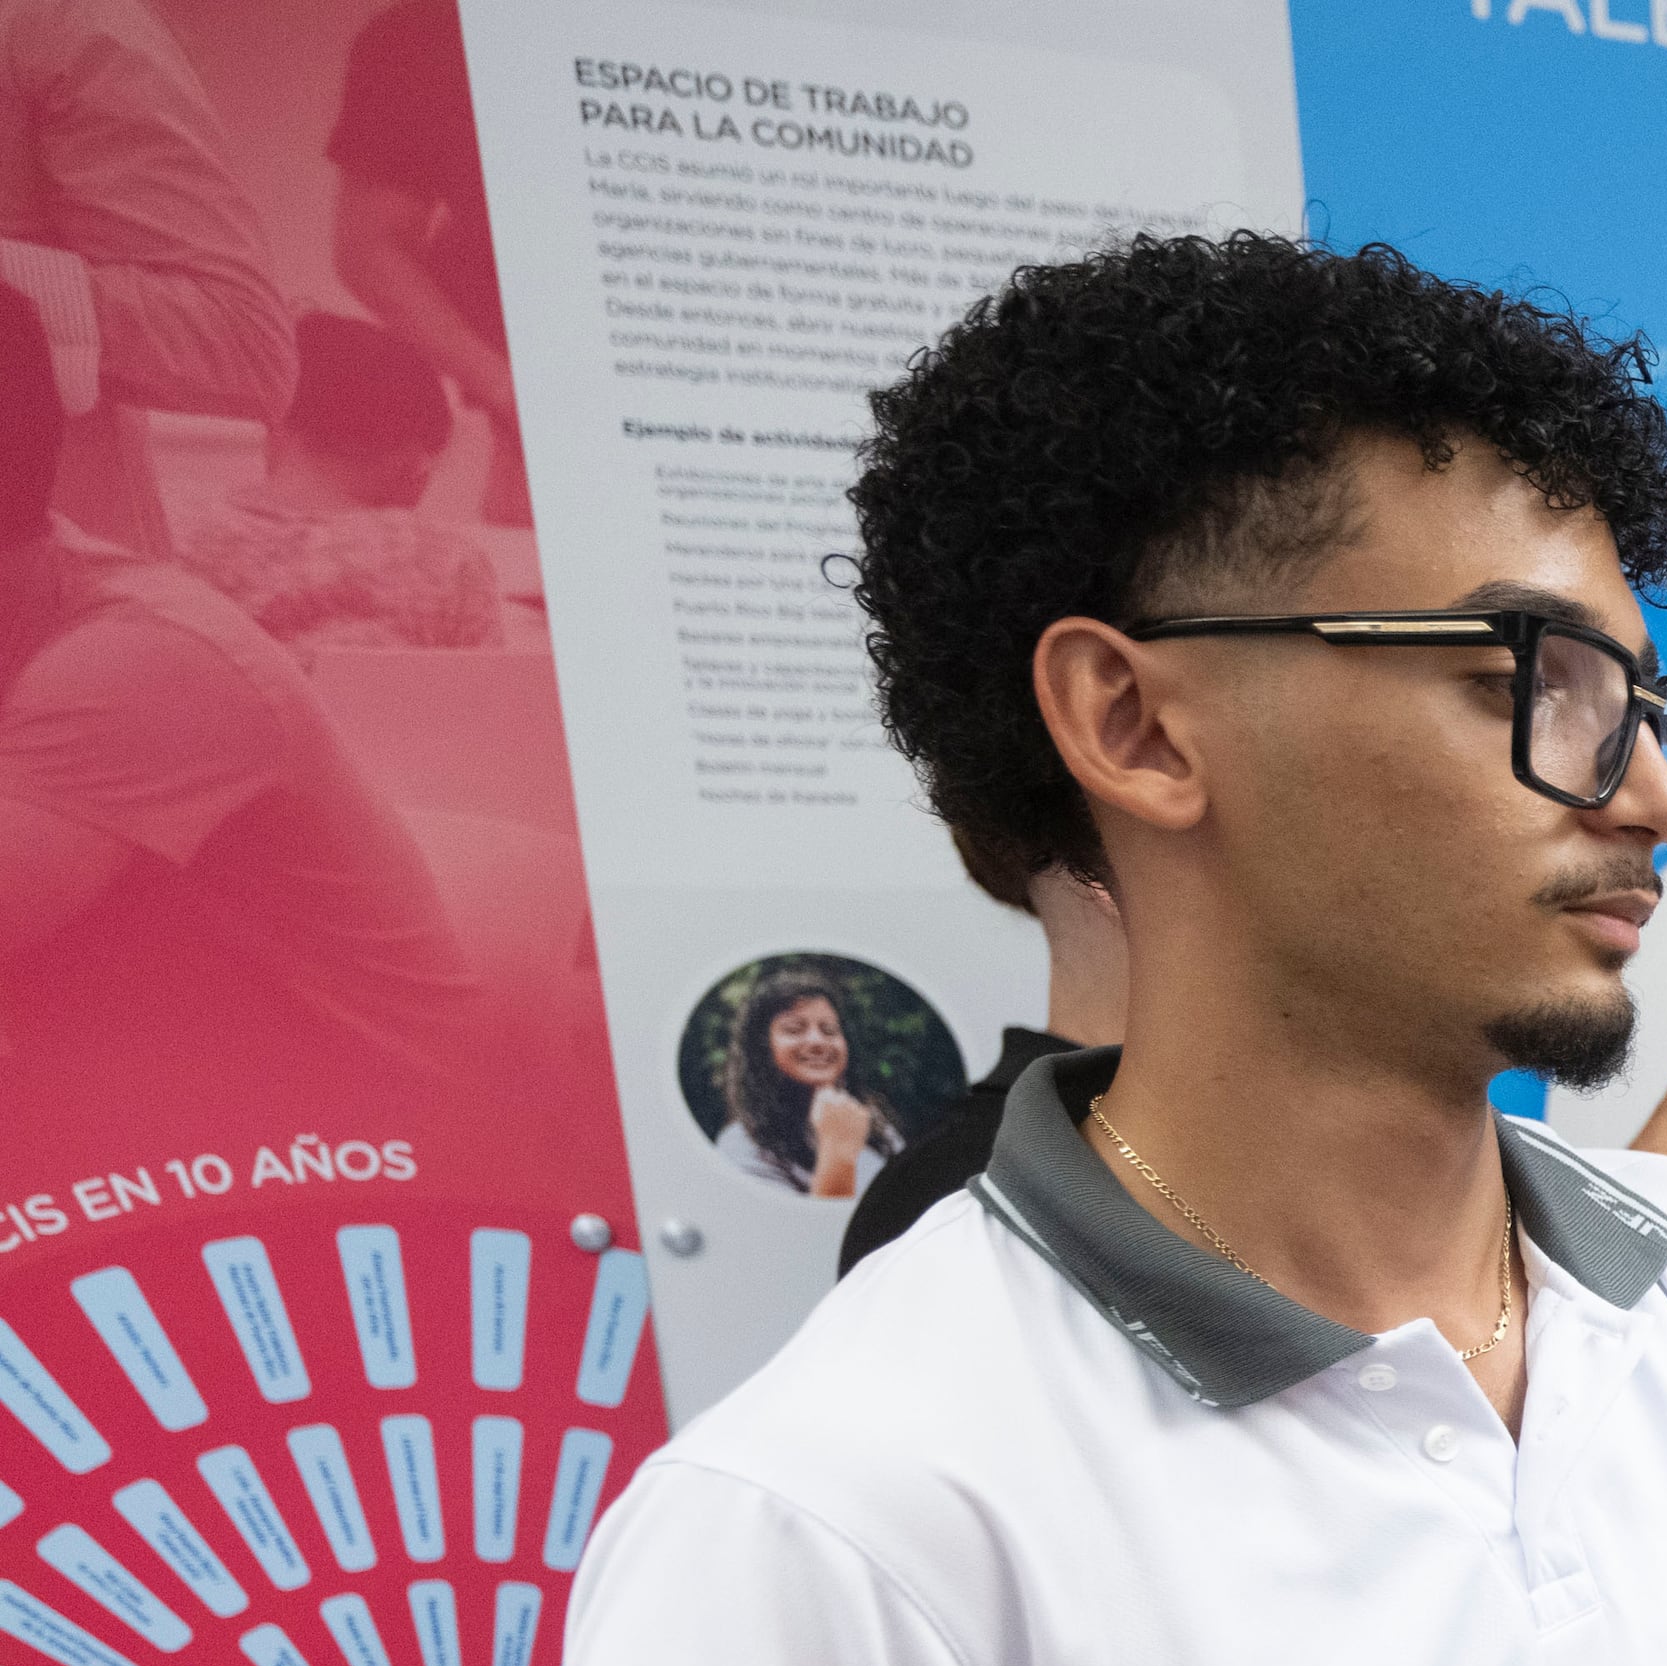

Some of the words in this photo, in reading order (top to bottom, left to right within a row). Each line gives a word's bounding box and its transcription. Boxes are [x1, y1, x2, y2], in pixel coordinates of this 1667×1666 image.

[574, 57, 733, 102] ESPACIO
[743, 76, 793, 110] DE
[802, 83, 970, 131] TRABAJO
[580, 97, 684, 137] PARA
[691, 111, 743, 144] LA
[750, 117, 975, 170] COMUNIDAD
[719, 427, 746, 445] de
[751, 430, 860, 452] actividade
[72, 1166, 162, 1223] EN
[165, 1152, 234, 1200] 10
[250, 1132, 419, 1189] AÑOS
